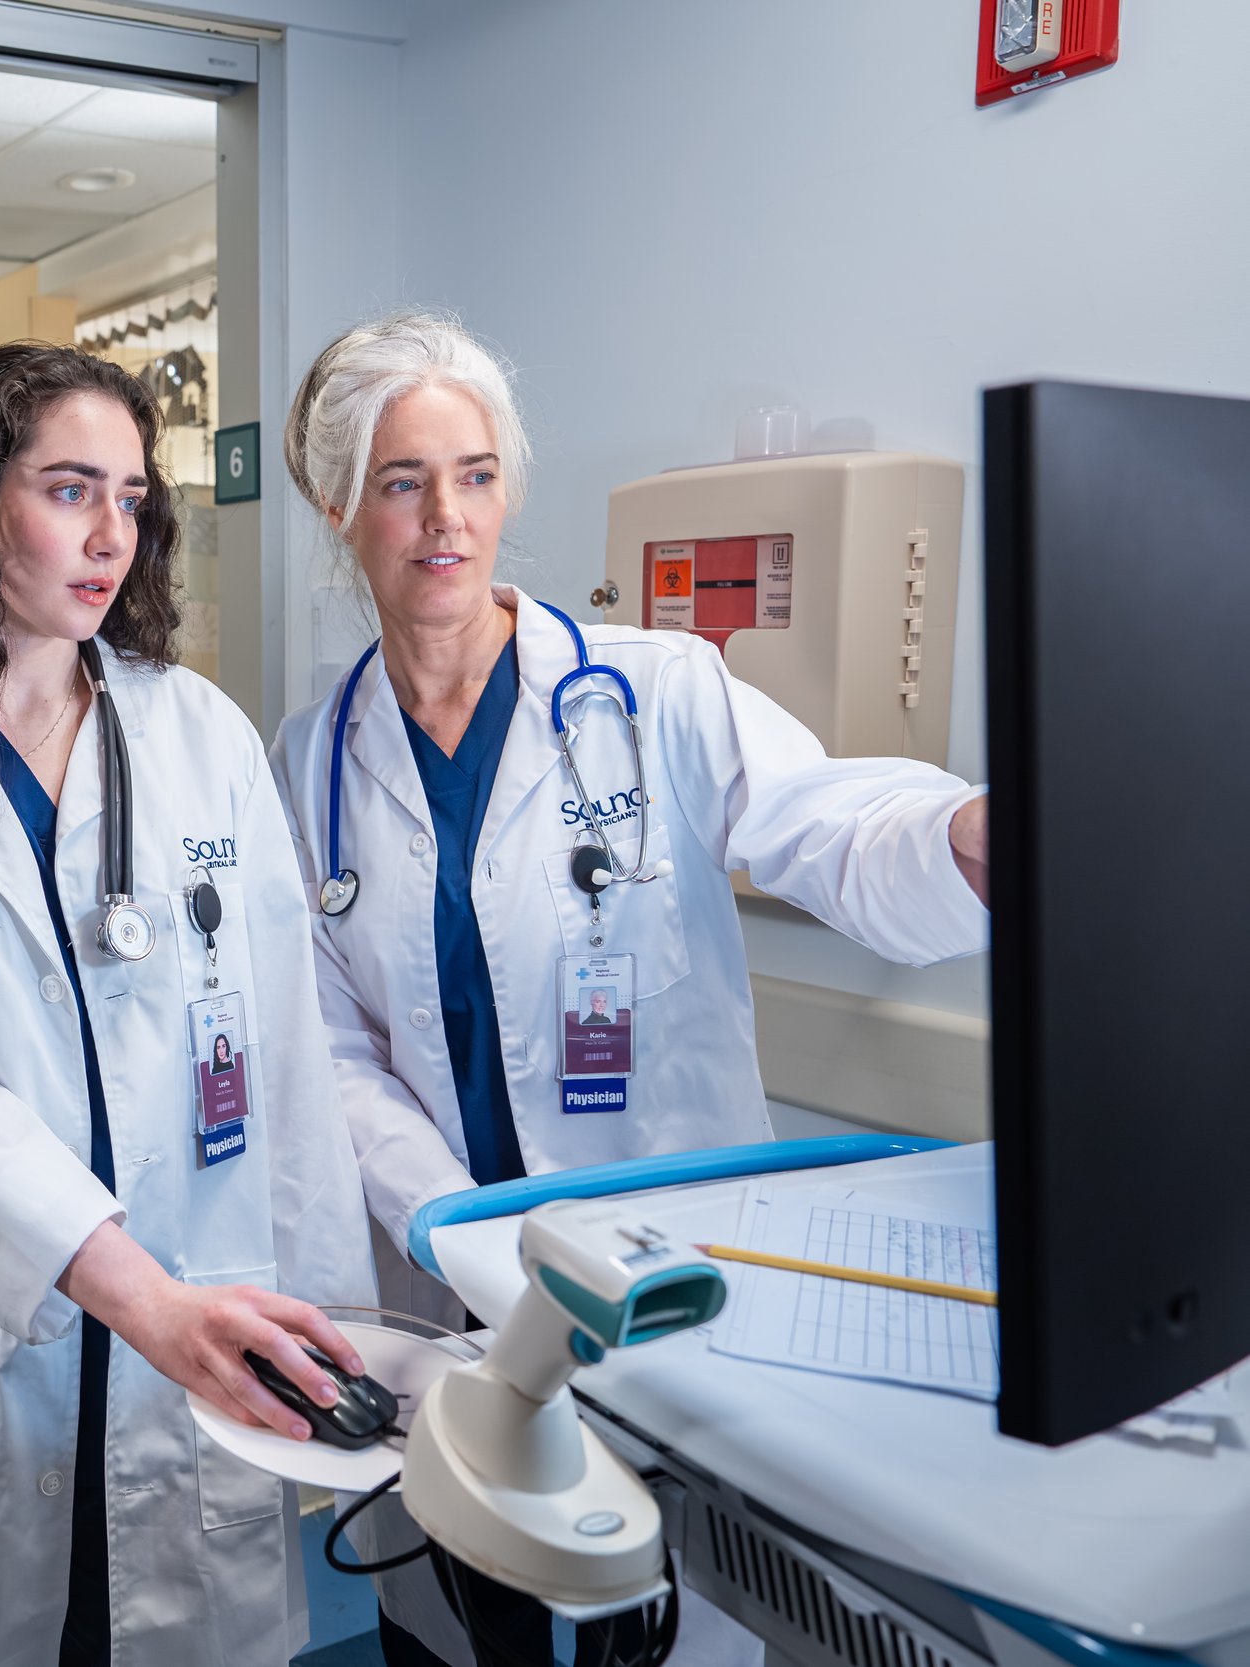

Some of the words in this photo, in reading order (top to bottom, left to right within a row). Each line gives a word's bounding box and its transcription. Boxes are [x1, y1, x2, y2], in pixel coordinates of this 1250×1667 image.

[229, 446, 243, 479] 6
[217, 1079, 231, 1089] Leyla
[565, 1091, 624, 1106] Physician
[205, 1132, 244, 1158] Physician
